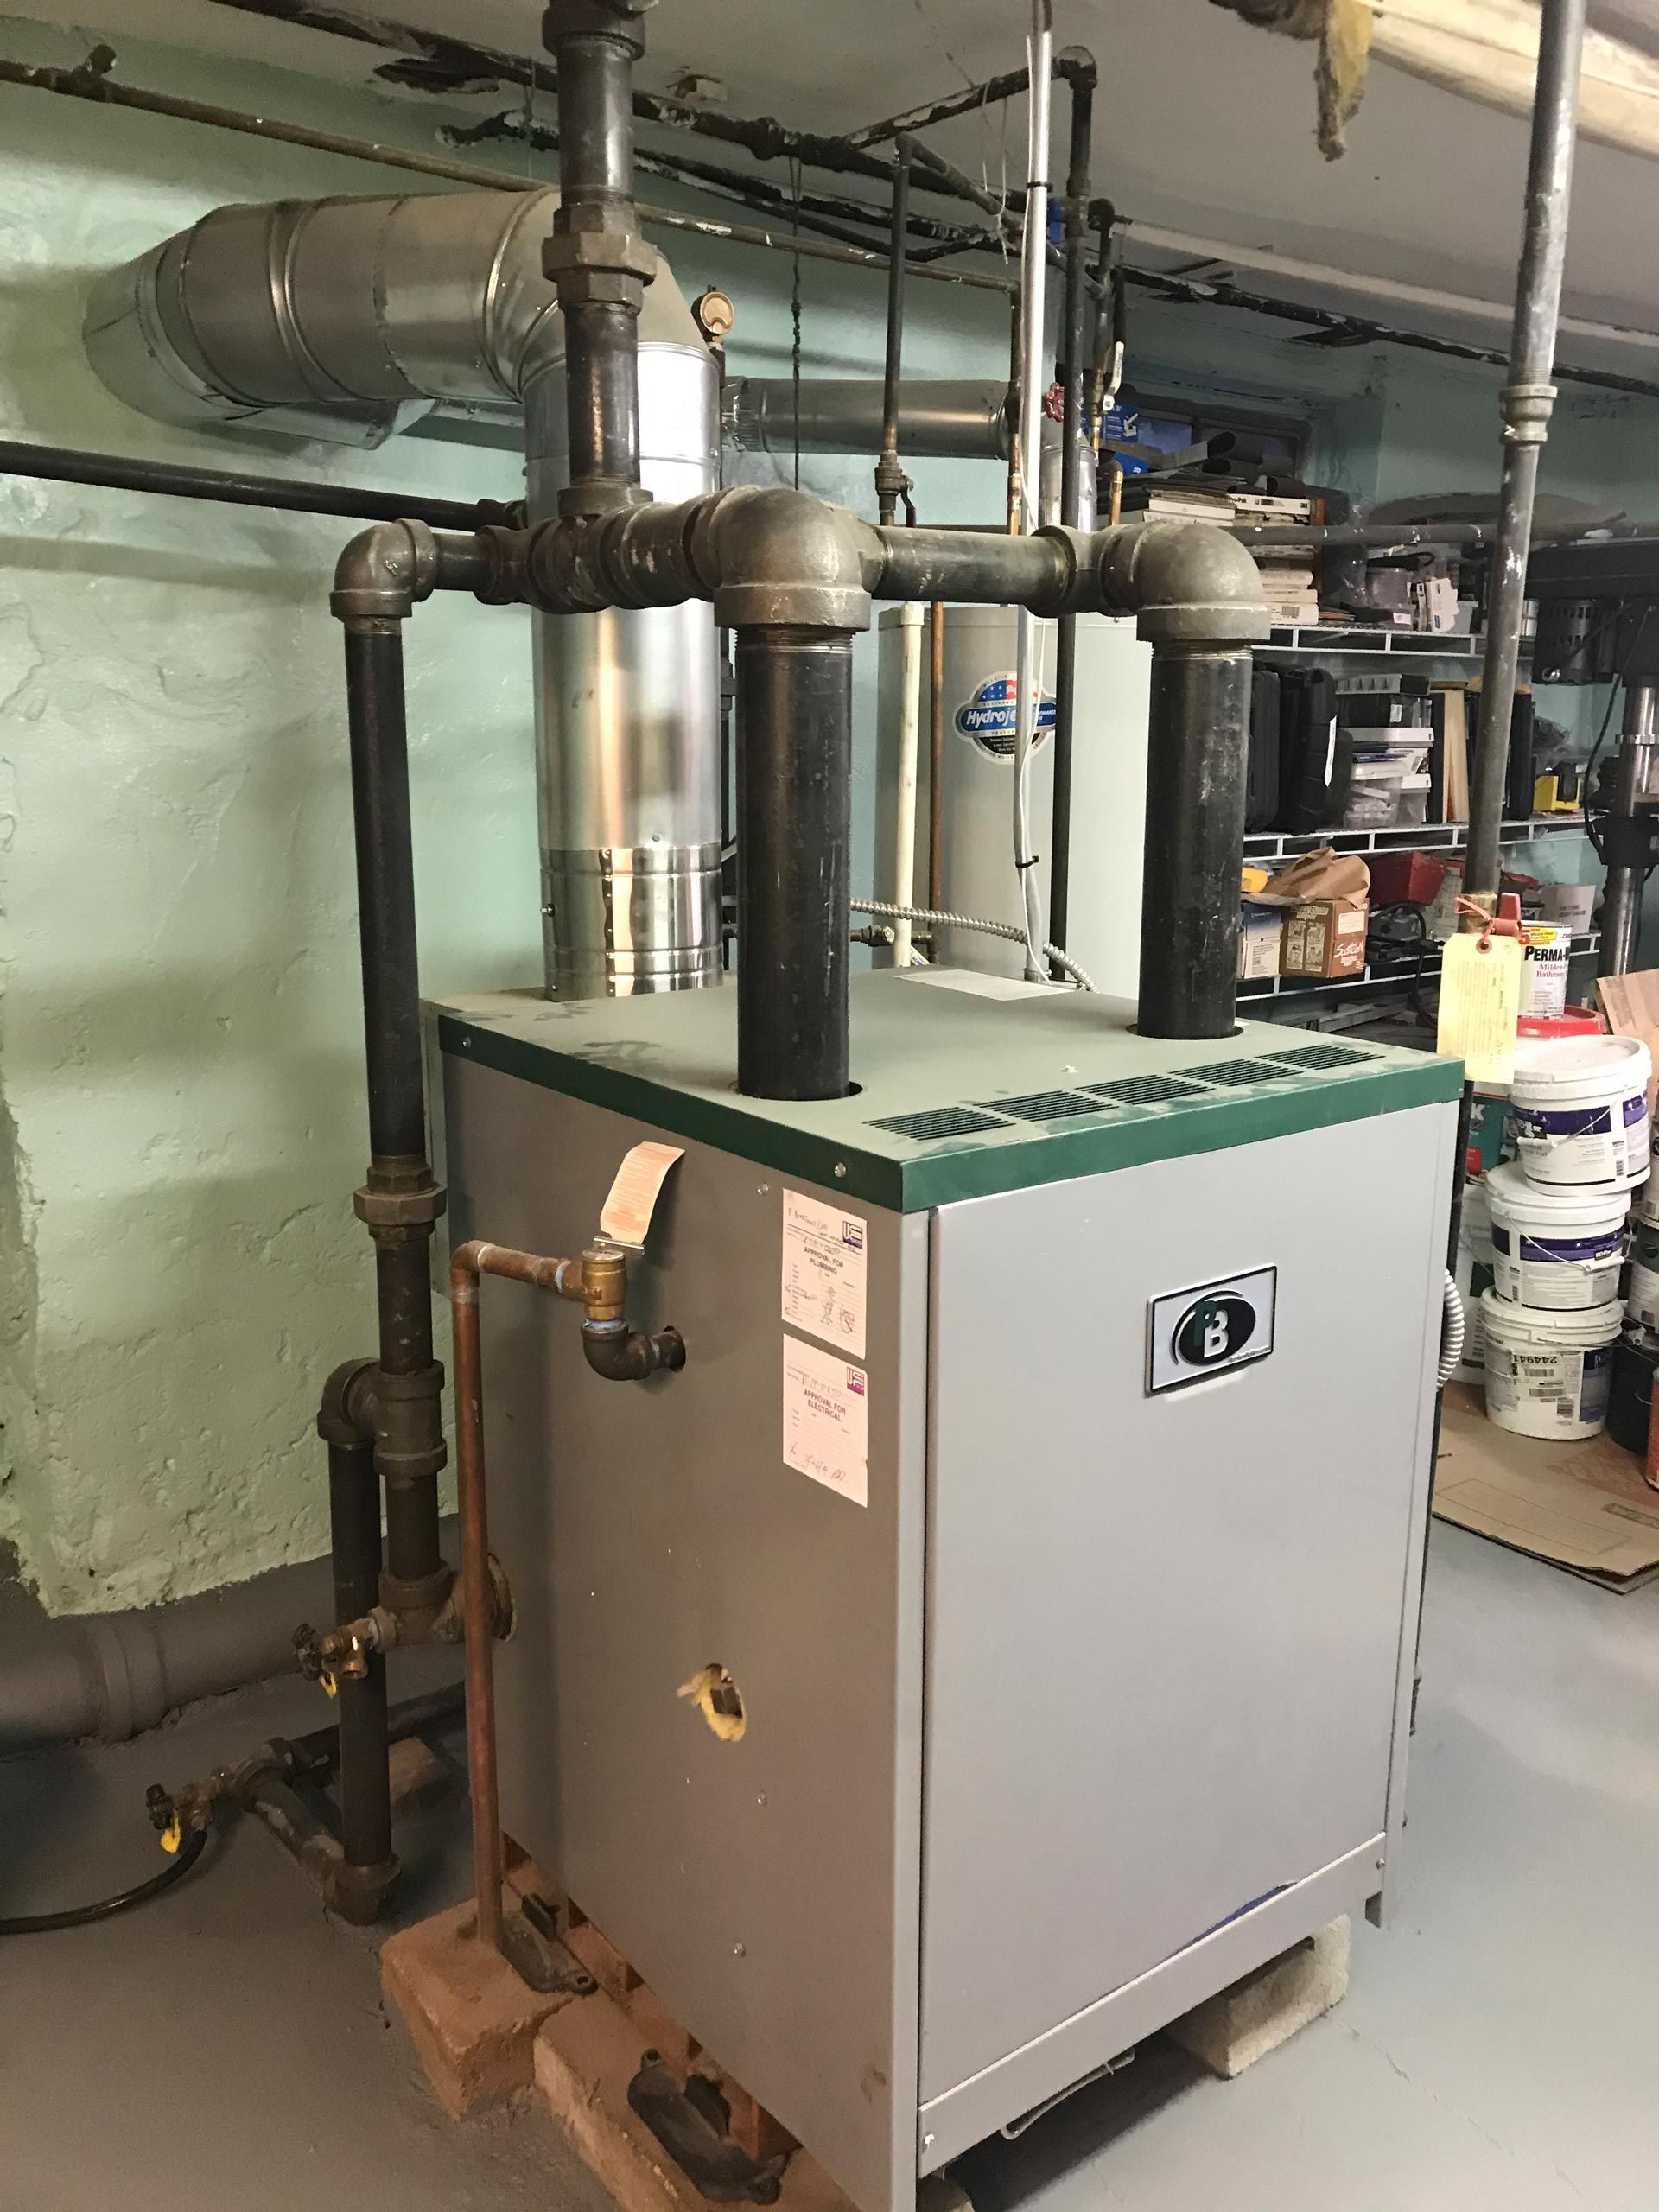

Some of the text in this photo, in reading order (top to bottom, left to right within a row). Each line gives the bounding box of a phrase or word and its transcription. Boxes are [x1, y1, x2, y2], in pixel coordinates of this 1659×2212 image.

[804, 1246, 844, 1268] APPROVAL FOR
[810, 1257, 837, 1274] PLUMBING
[1513, 1354, 1557, 1364] 244941
[804, 1389, 846, 1415] APPROVAL FOR
[808, 1399, 842, 1422] ELECTRICAL
